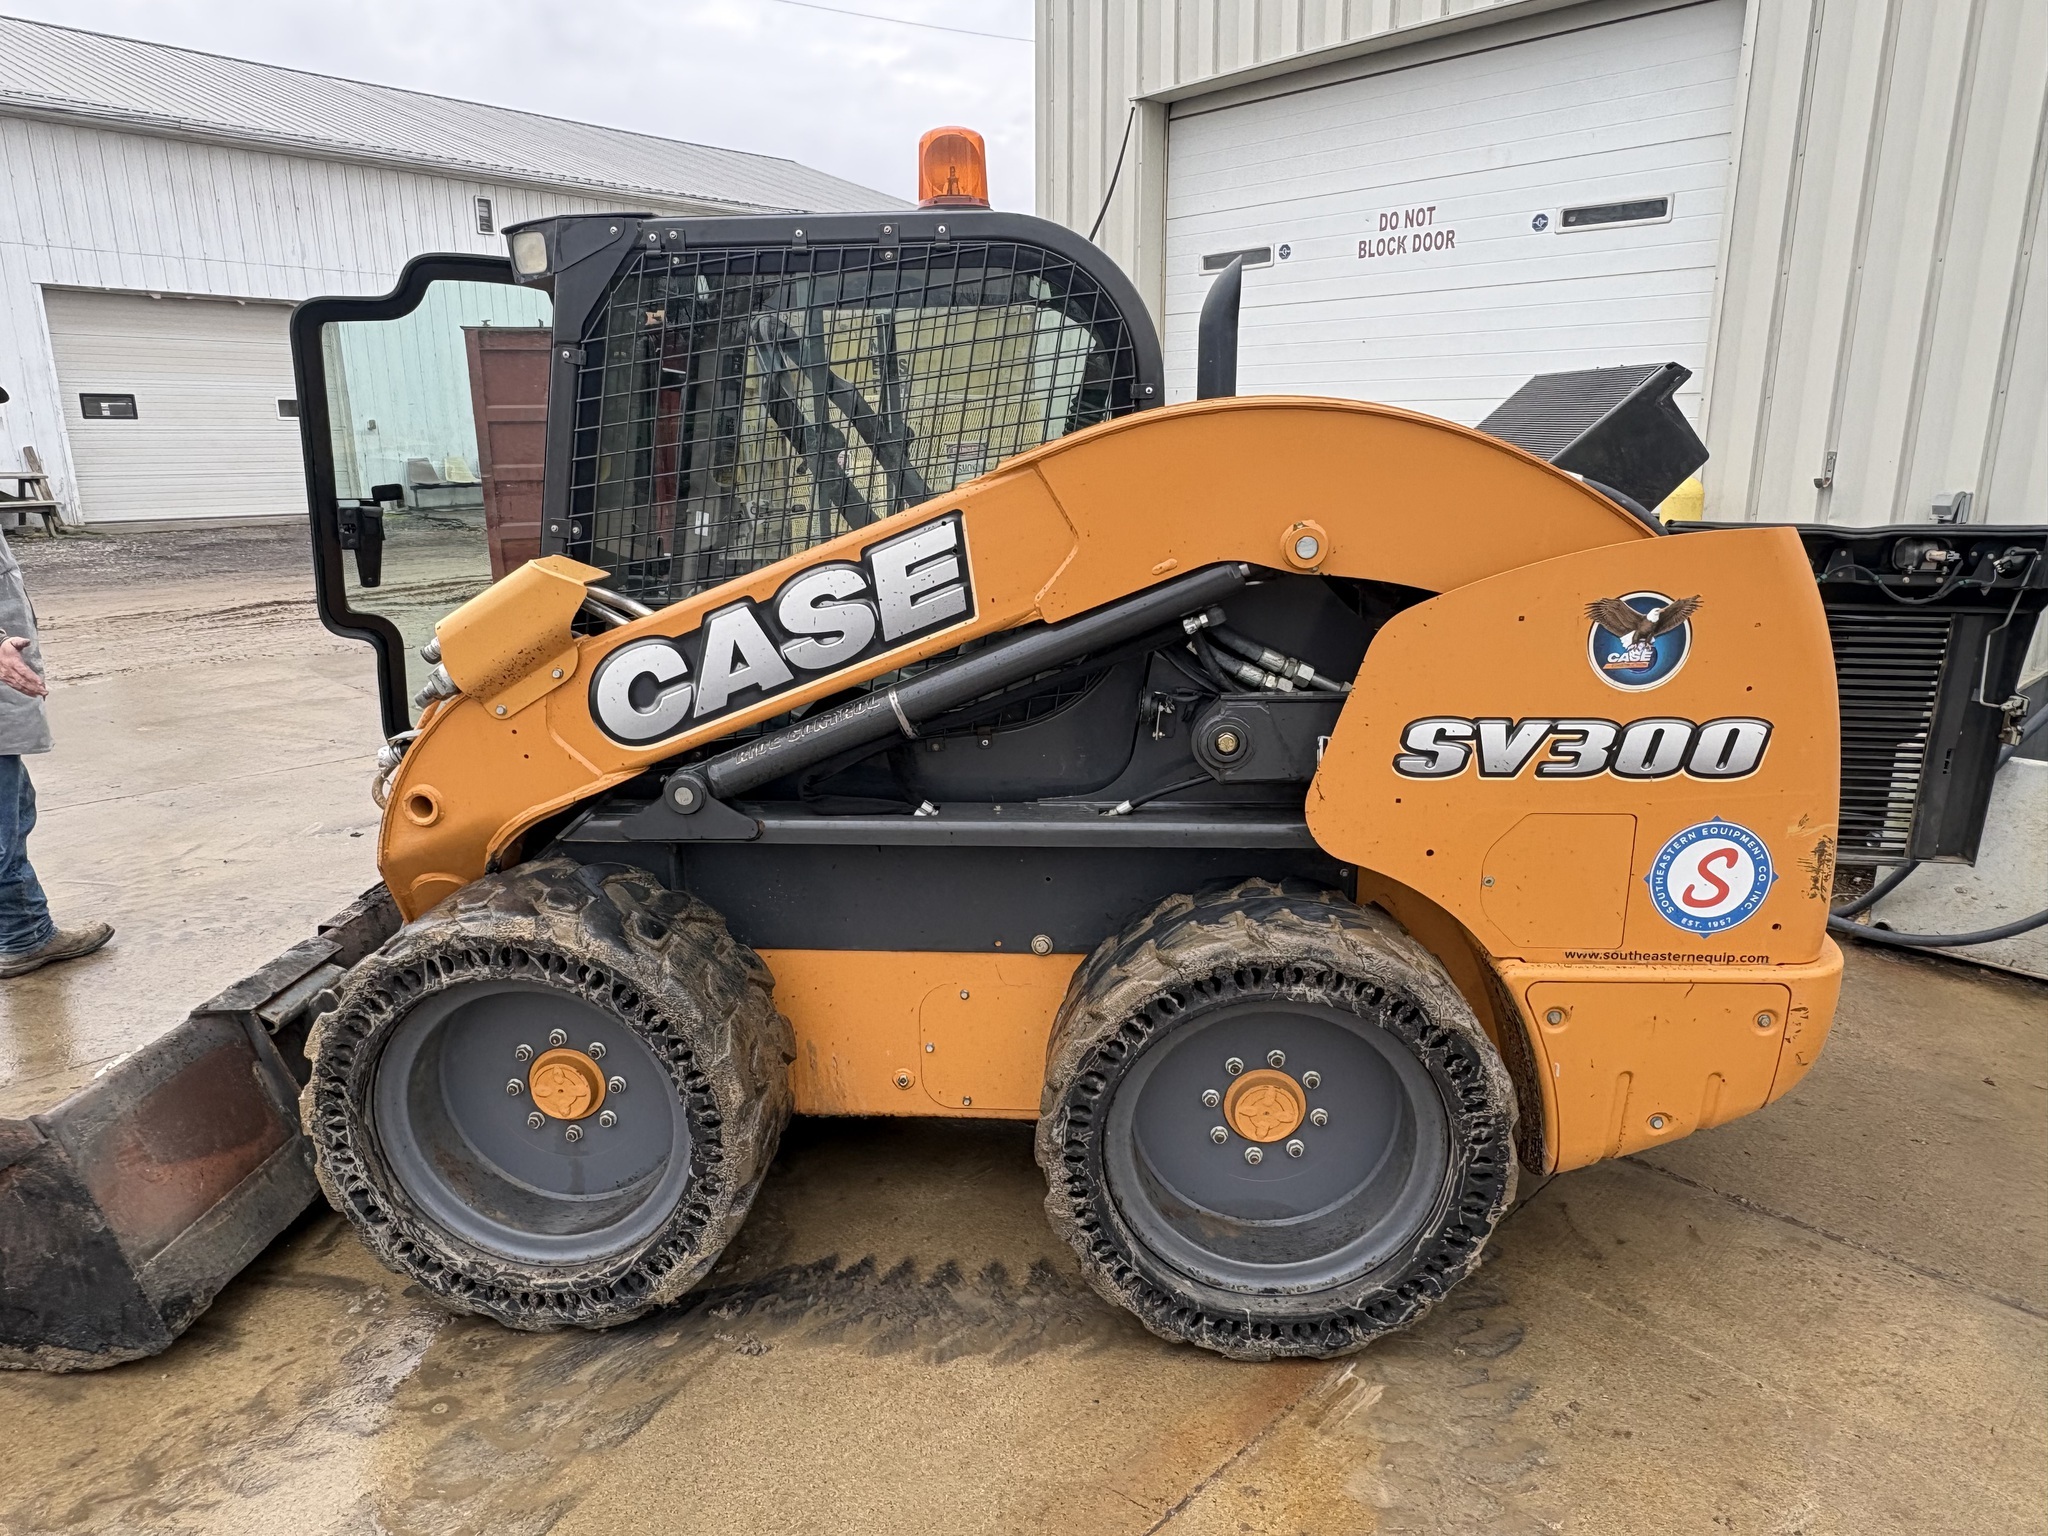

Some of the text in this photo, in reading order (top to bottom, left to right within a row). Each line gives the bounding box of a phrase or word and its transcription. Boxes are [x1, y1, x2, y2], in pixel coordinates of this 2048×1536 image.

[1379, 206, 1436, 232] DO NOT
[1358, 229, 1455, 259] BLOCK DOOR
[590, 512, 974, 744] CASE
[1607, 649, 1653, 663] CASE
[734, 736, 783, 765] RIDE
[1393, 716, 1774, 780] SV300
[1655, 827, 1767, 914] SOUTHEASTERN EQUIPMENT CO. INC.
[1682, 848, 1739, 908] S
[1680, 916, 1732, 929] EST. 1957
[1564, 950, 1770, 964] www.southeasternequip.com
